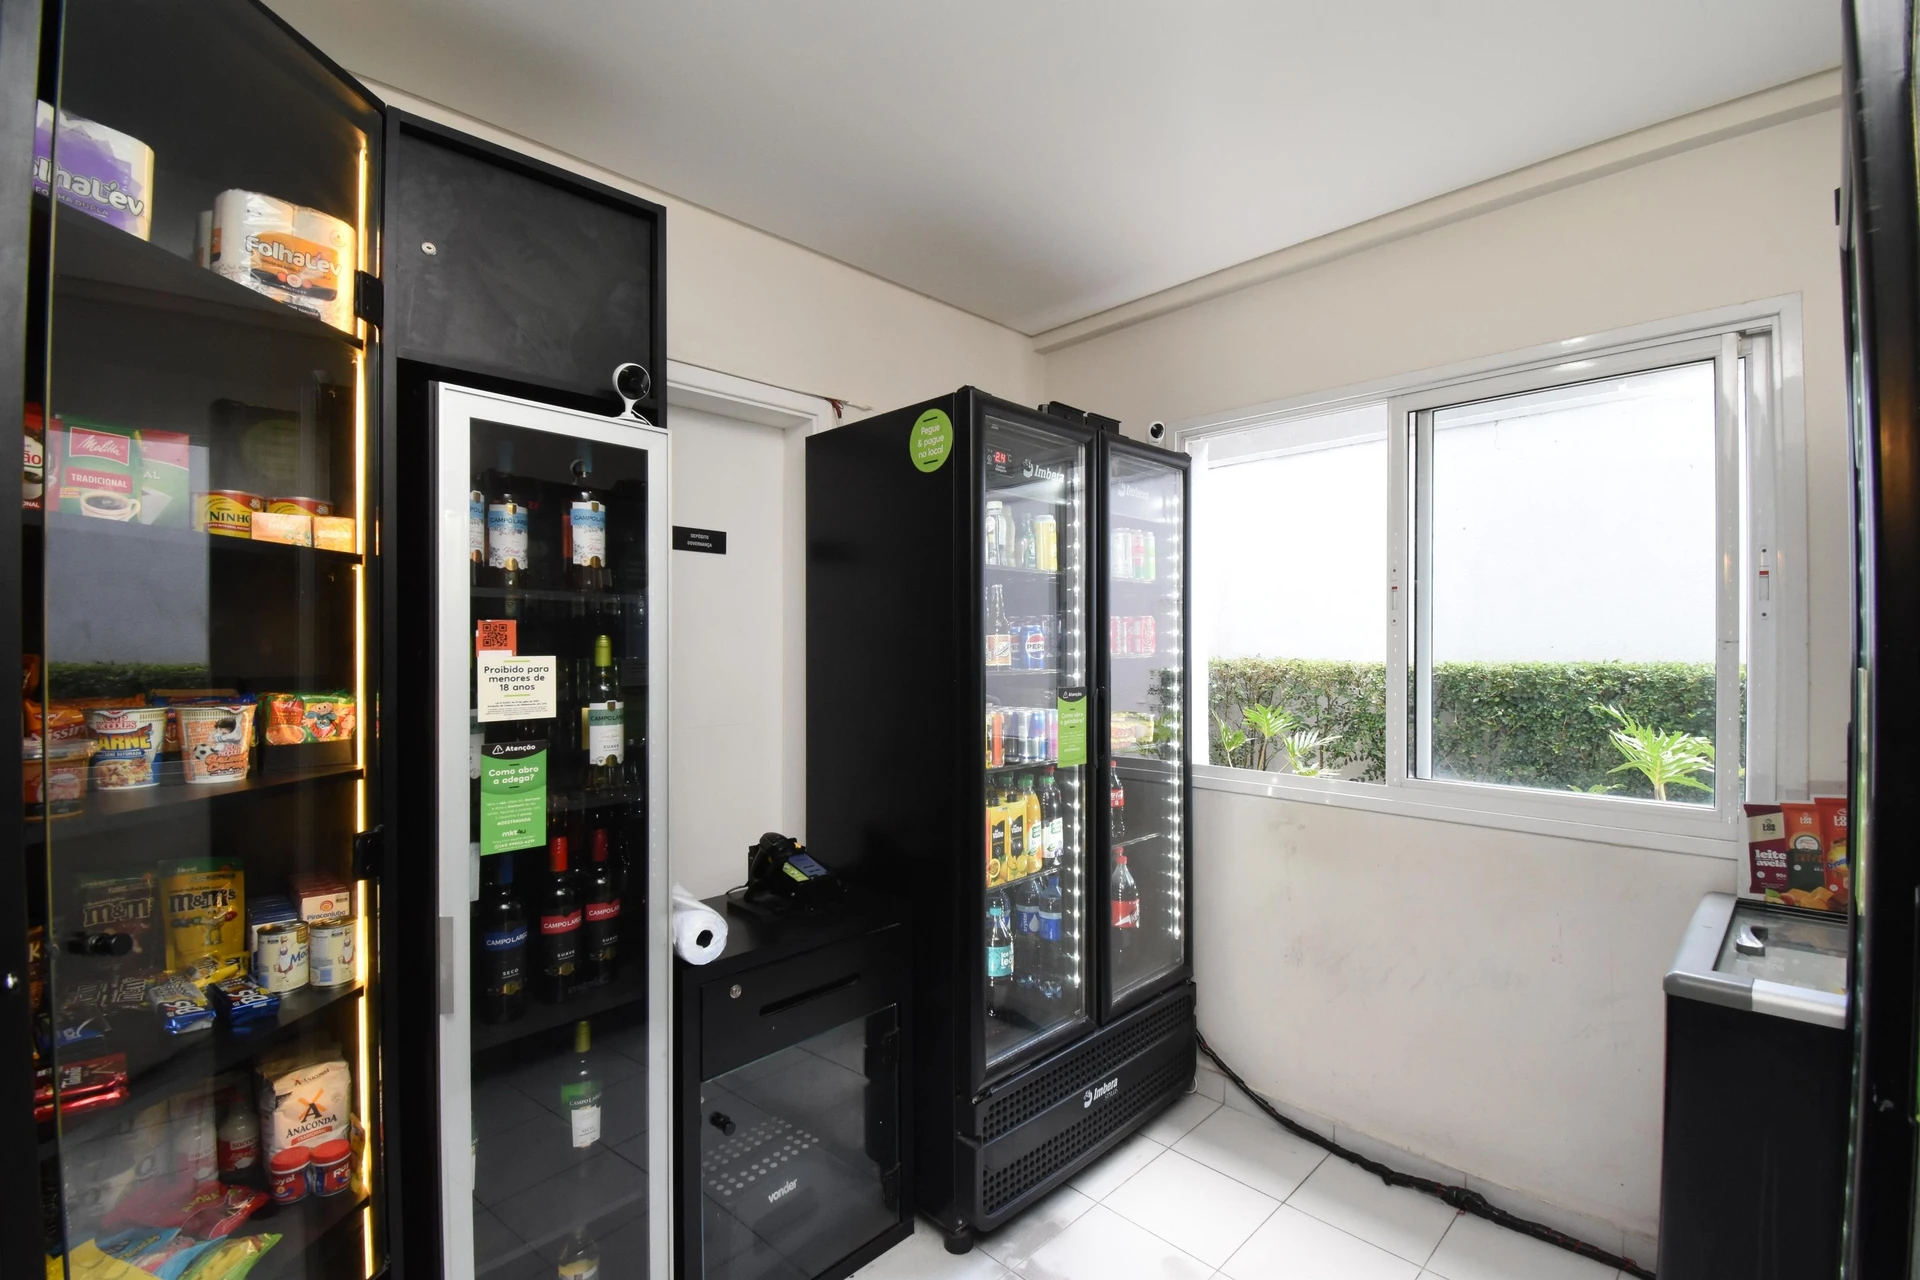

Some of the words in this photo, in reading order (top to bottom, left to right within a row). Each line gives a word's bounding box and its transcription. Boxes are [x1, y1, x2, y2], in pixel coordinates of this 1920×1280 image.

[921, 424, 940, 435] Pegue
[77, 434, 122, 456] Melitta
[924, 435, 944, 448] pague
[918, 451, 927, 459] no
[928, 444, 943, 456] local
[1034, 464, 1065, 483] Imbera
[71, 473, 128, 489] TRADICIONAL
[687, 540, 712, 548] GOVERNANÇA
[484, 665, 524, 674] Proibido
[488, 675, 531, 683] menores
[533, 674, 545, 682] de
[499, 683, 509, 691] 18
[96, 720, 137, 730] NOODLES
[99, 723, 152, 751] ARNE
[505, 744, 536, 753] Atenção
[488, 769, 516, 777] Como
[518, 766, 539, 775] abro
[502, 773, 535, 784] adega?
[1754, 849, 1787, 860] leite
[1756, 860, 1787, 868] avelã
[557, 949, 575, 958] SUAVE
[502, 967, 519, 976] SECO
[1093, 1077, 1118, 1101] Imbera
[285, 1113, 338, 1139] ANACONDA
[768, 1178, 798, 1203] vonder
